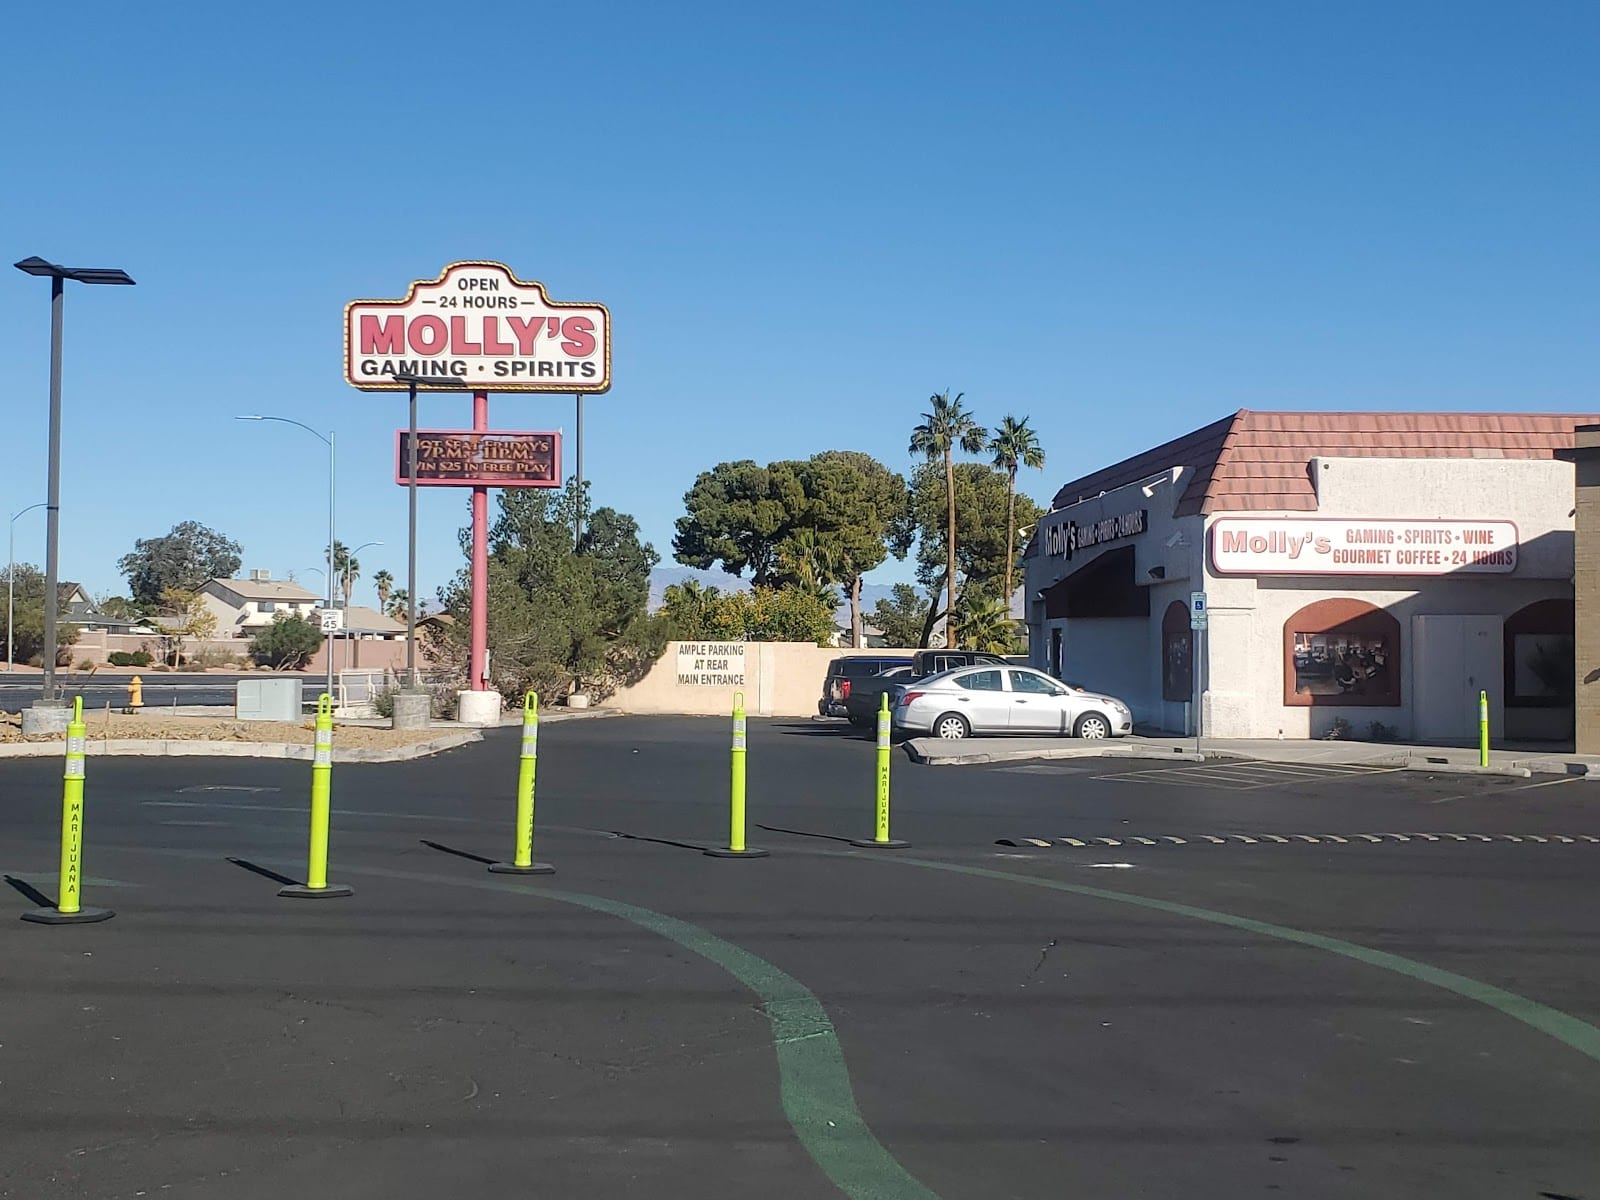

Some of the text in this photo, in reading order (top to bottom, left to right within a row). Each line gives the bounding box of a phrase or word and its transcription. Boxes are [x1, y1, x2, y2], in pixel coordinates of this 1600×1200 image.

[458, 278, 499, 291] OPEN
[439, 296, 518, 309] 24 HOURS
[360, 314, 597, 358] MOLLY'S
[361, 359, 596, 378] GAMING SPIRITS
[445, 439, 479, 450] SEAT
[439, 461, 462, 471] $25
[464, 462, 479, 471] IN
[484, 463, 513, 472] FREE
[516, 463, 548, 472] PLAY
[1045, 521, 1076, 560] Molly's
[1346, 529, 1494, 545] GAMING SPIRITS WINE
[1222, 531, 1332, 559] Molly's
[1333, 549, 1513, 566] GOURMET COFFEE 24 HOURS
[323, 620, 337, 629] 45
[679, 644, 744, 655] AMPLE PARKING
[694, 659, 728, 670] AT REAR
[678, 673, 744, 685] MAIN ENTRANCE
[68, 803, 80, 893] MARIJUANA
